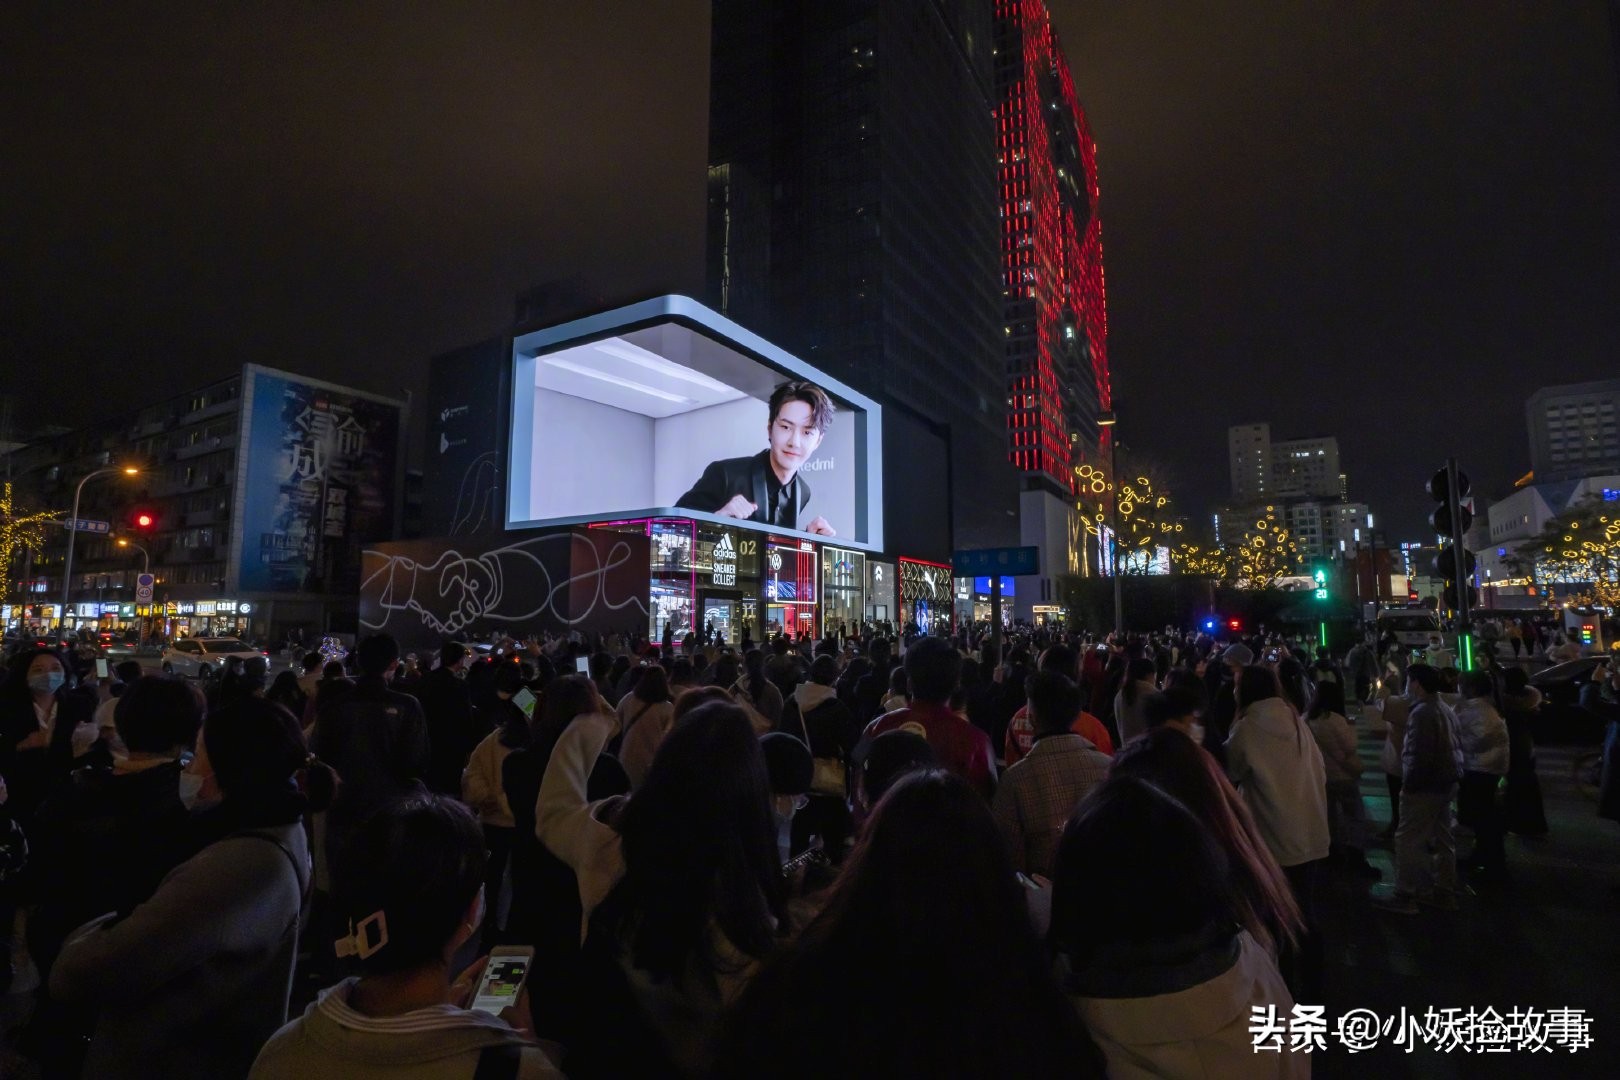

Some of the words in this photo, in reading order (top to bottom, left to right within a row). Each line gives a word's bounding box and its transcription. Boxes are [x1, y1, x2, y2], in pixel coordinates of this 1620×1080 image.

[798, 456, 834, 472] edmi
[713, 548, 737, 559] adidas
[739, 540, 757, 556] 02
[713, 573, 736, 586] COLLECT
[1316, 589, 1328, 599] 20
